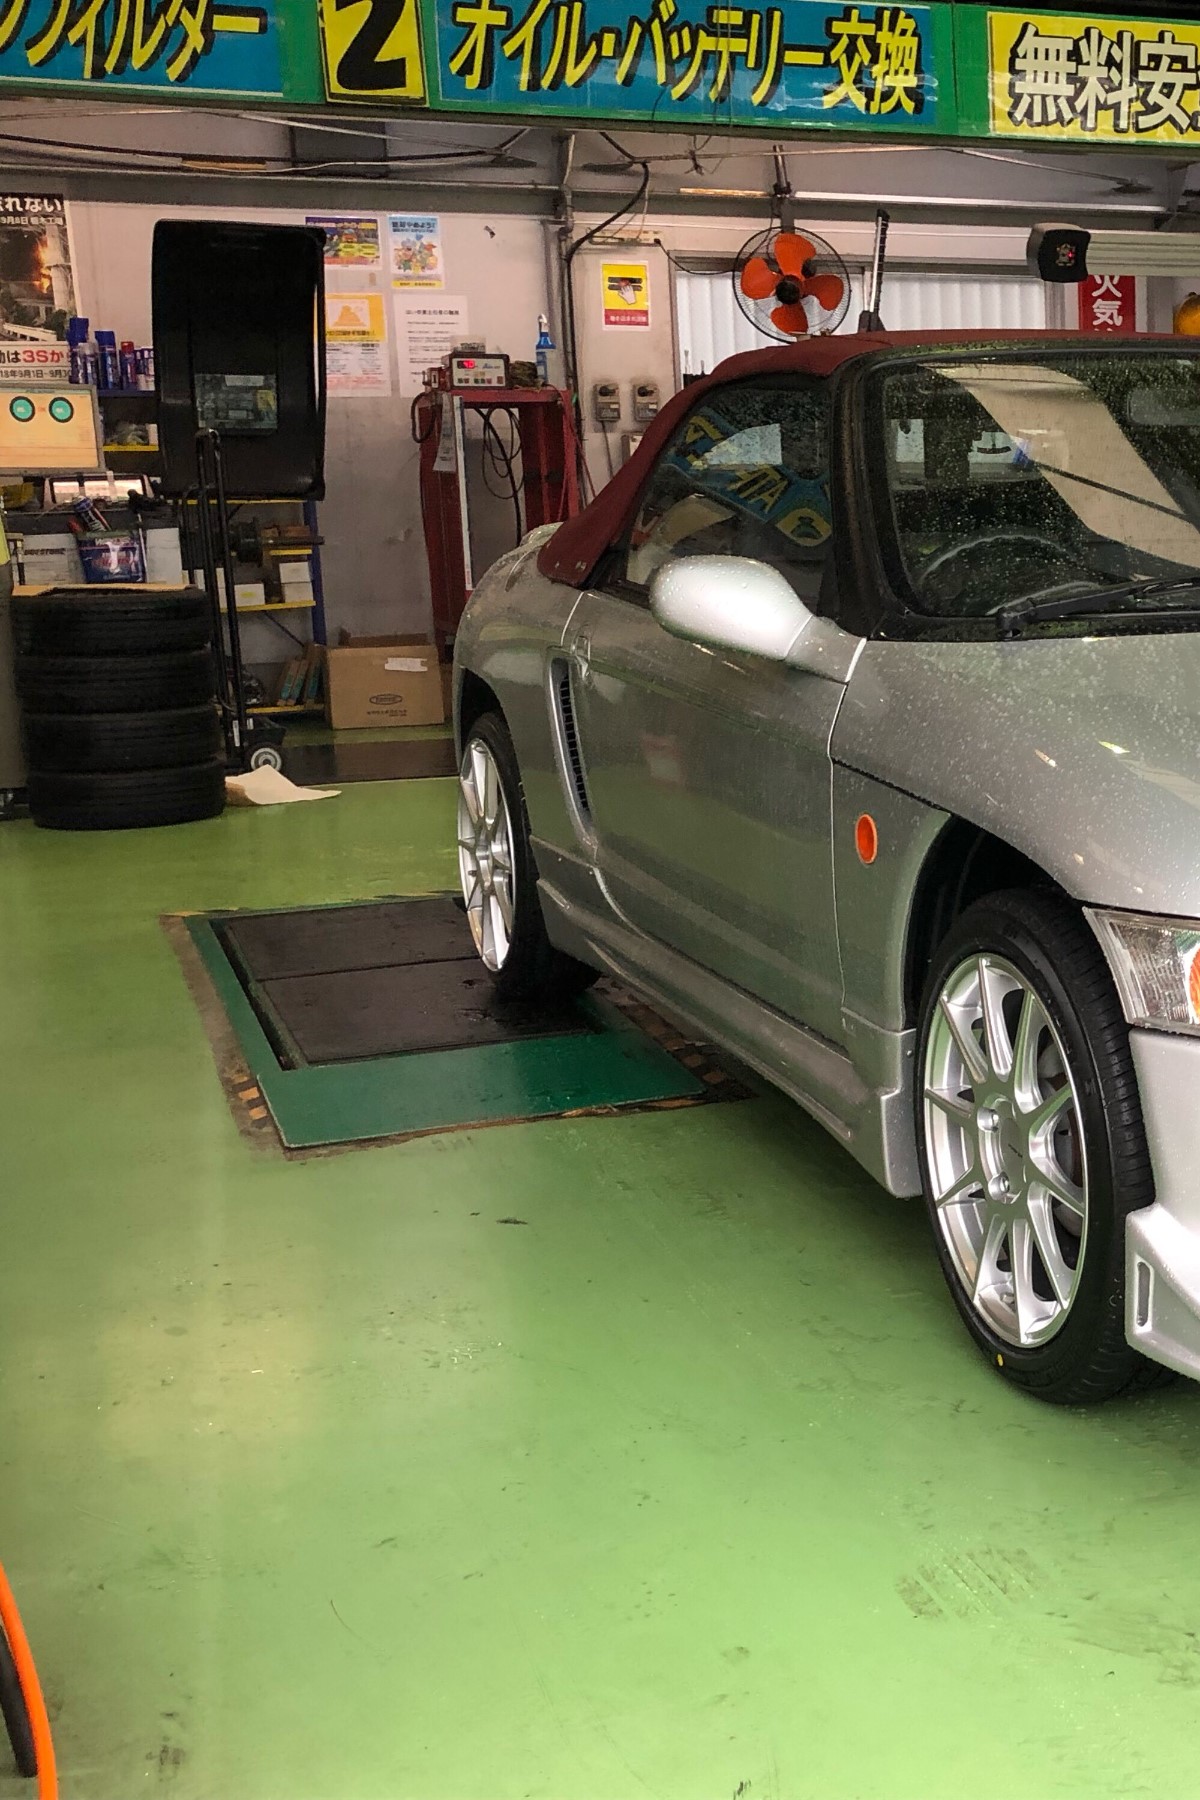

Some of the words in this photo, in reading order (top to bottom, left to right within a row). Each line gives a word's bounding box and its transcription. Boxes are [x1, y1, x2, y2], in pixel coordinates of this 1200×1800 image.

[336, 0, 408, 92] 2
[447, 0, 922, 115] オイル・バッテリー交換
[0, 196, 62, 212] れない
[1091, 275, 1123, 331] 火気
